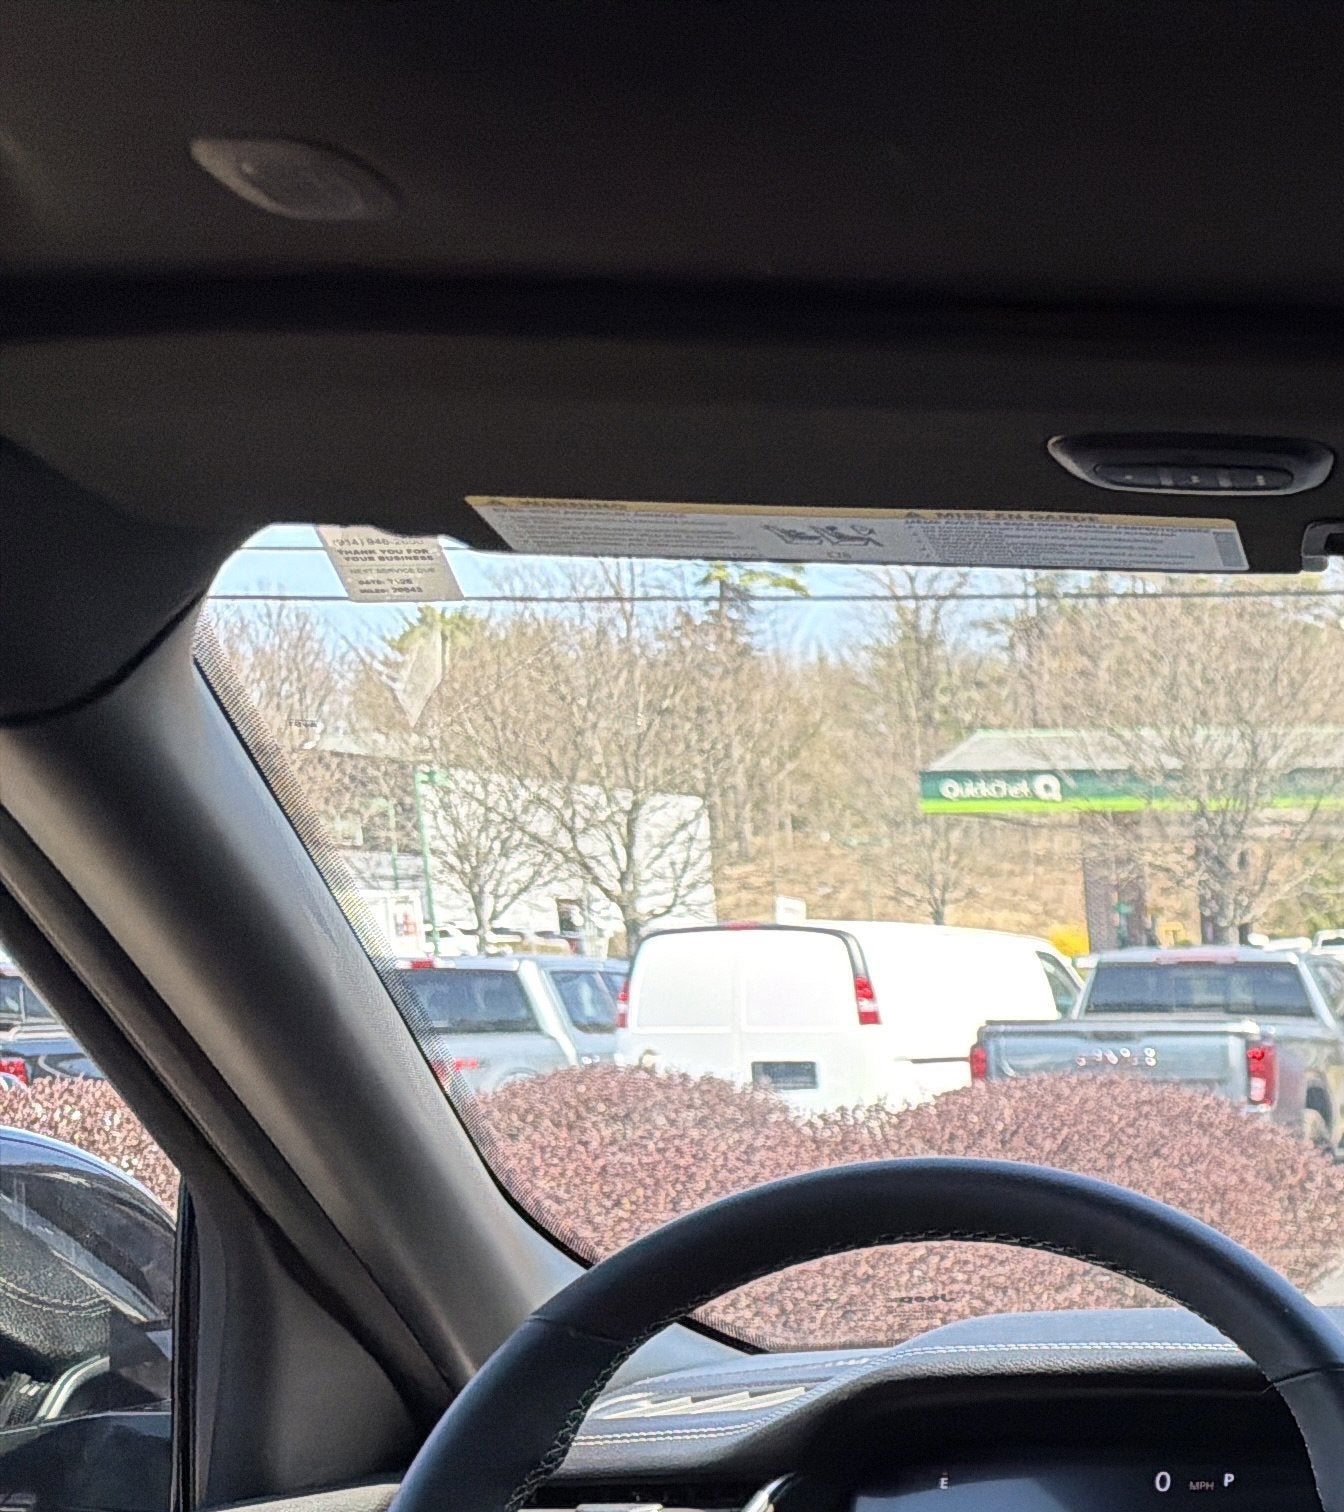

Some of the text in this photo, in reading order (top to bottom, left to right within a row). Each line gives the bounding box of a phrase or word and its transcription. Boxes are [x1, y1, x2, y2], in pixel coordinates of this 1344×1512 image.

[939, 1476, 949, 1490] E
[1154, 1471, 1214, 1493] 0 MPH
[1223, 1473, 1235, 1488] P
